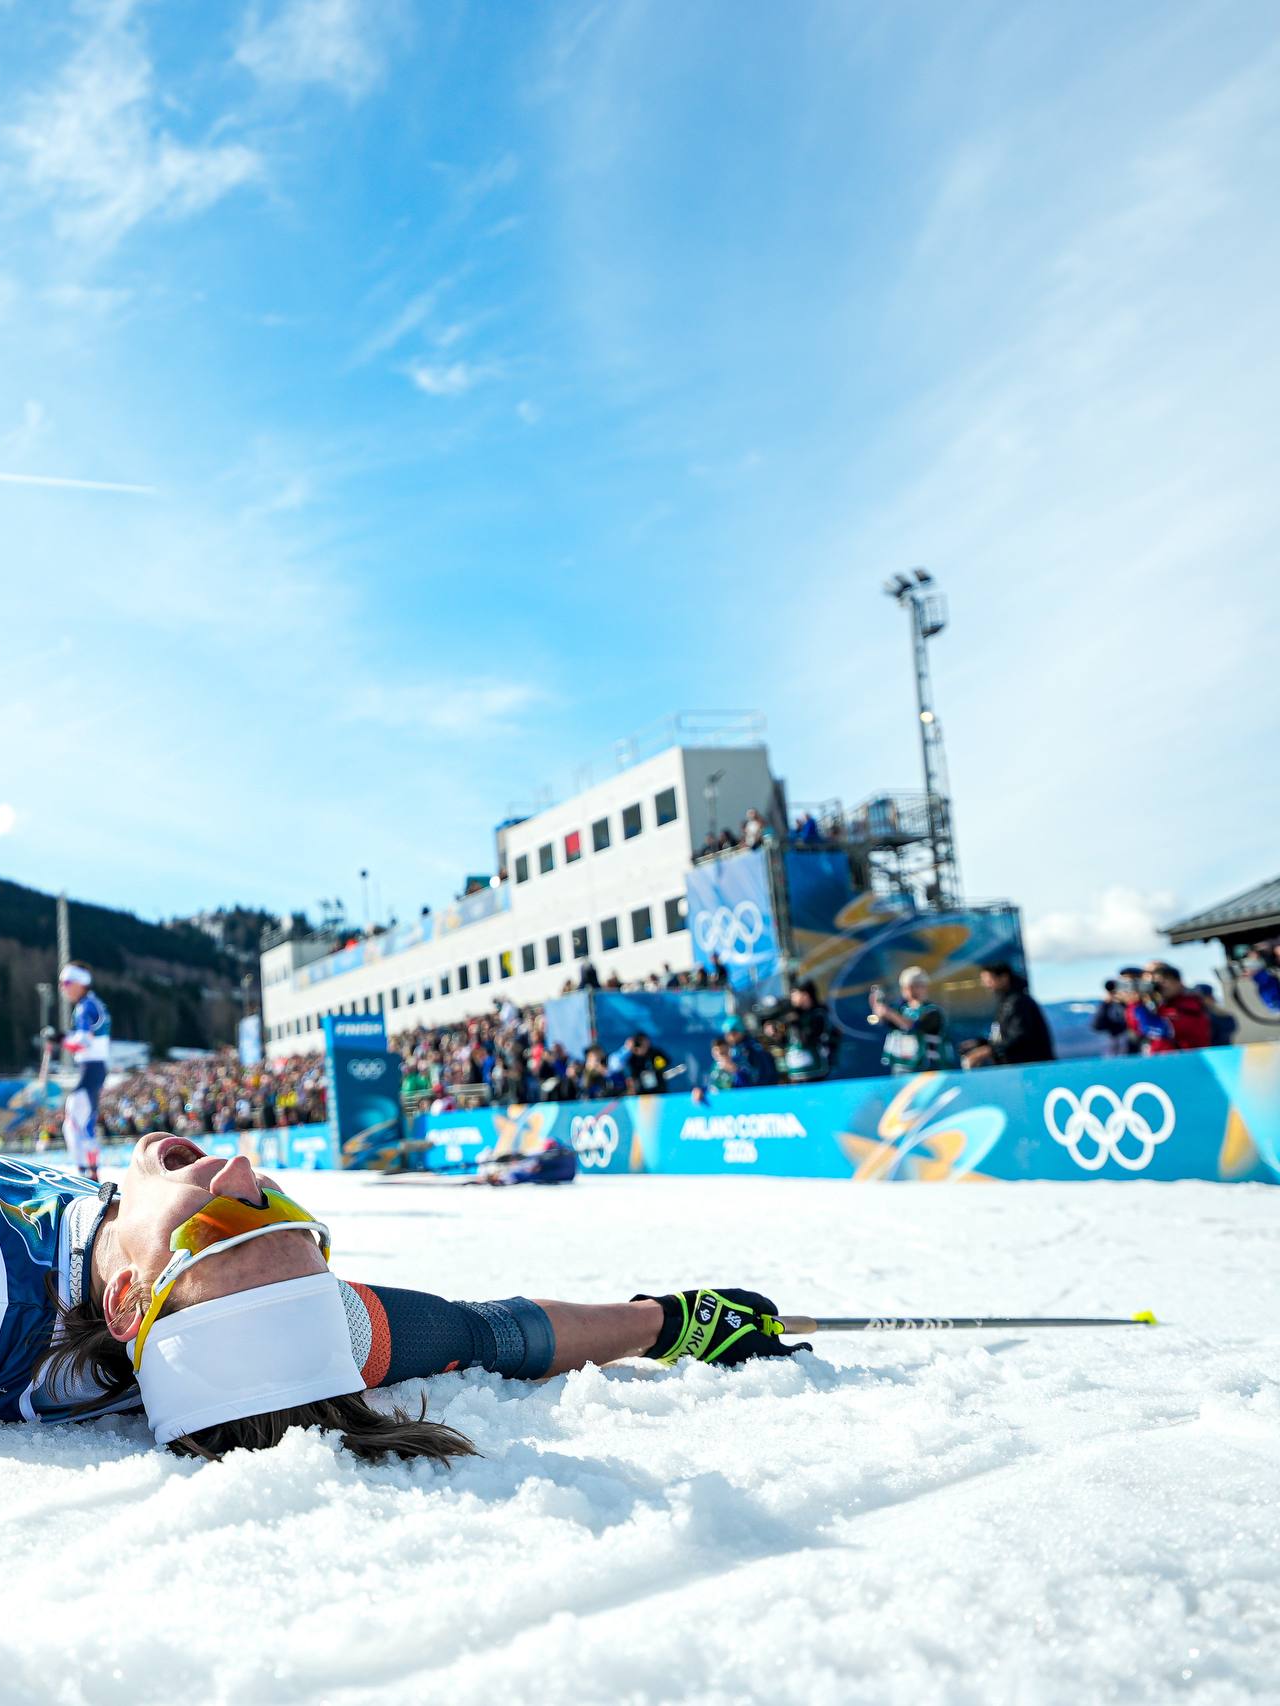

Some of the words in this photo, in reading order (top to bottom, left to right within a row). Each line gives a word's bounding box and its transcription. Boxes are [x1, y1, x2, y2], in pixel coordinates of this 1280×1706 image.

[680, 1115, 736, 1140] MILANO
[737, 1112, 807, 1139] CORTINA
[723, 1139, 758, 1164] 2026
